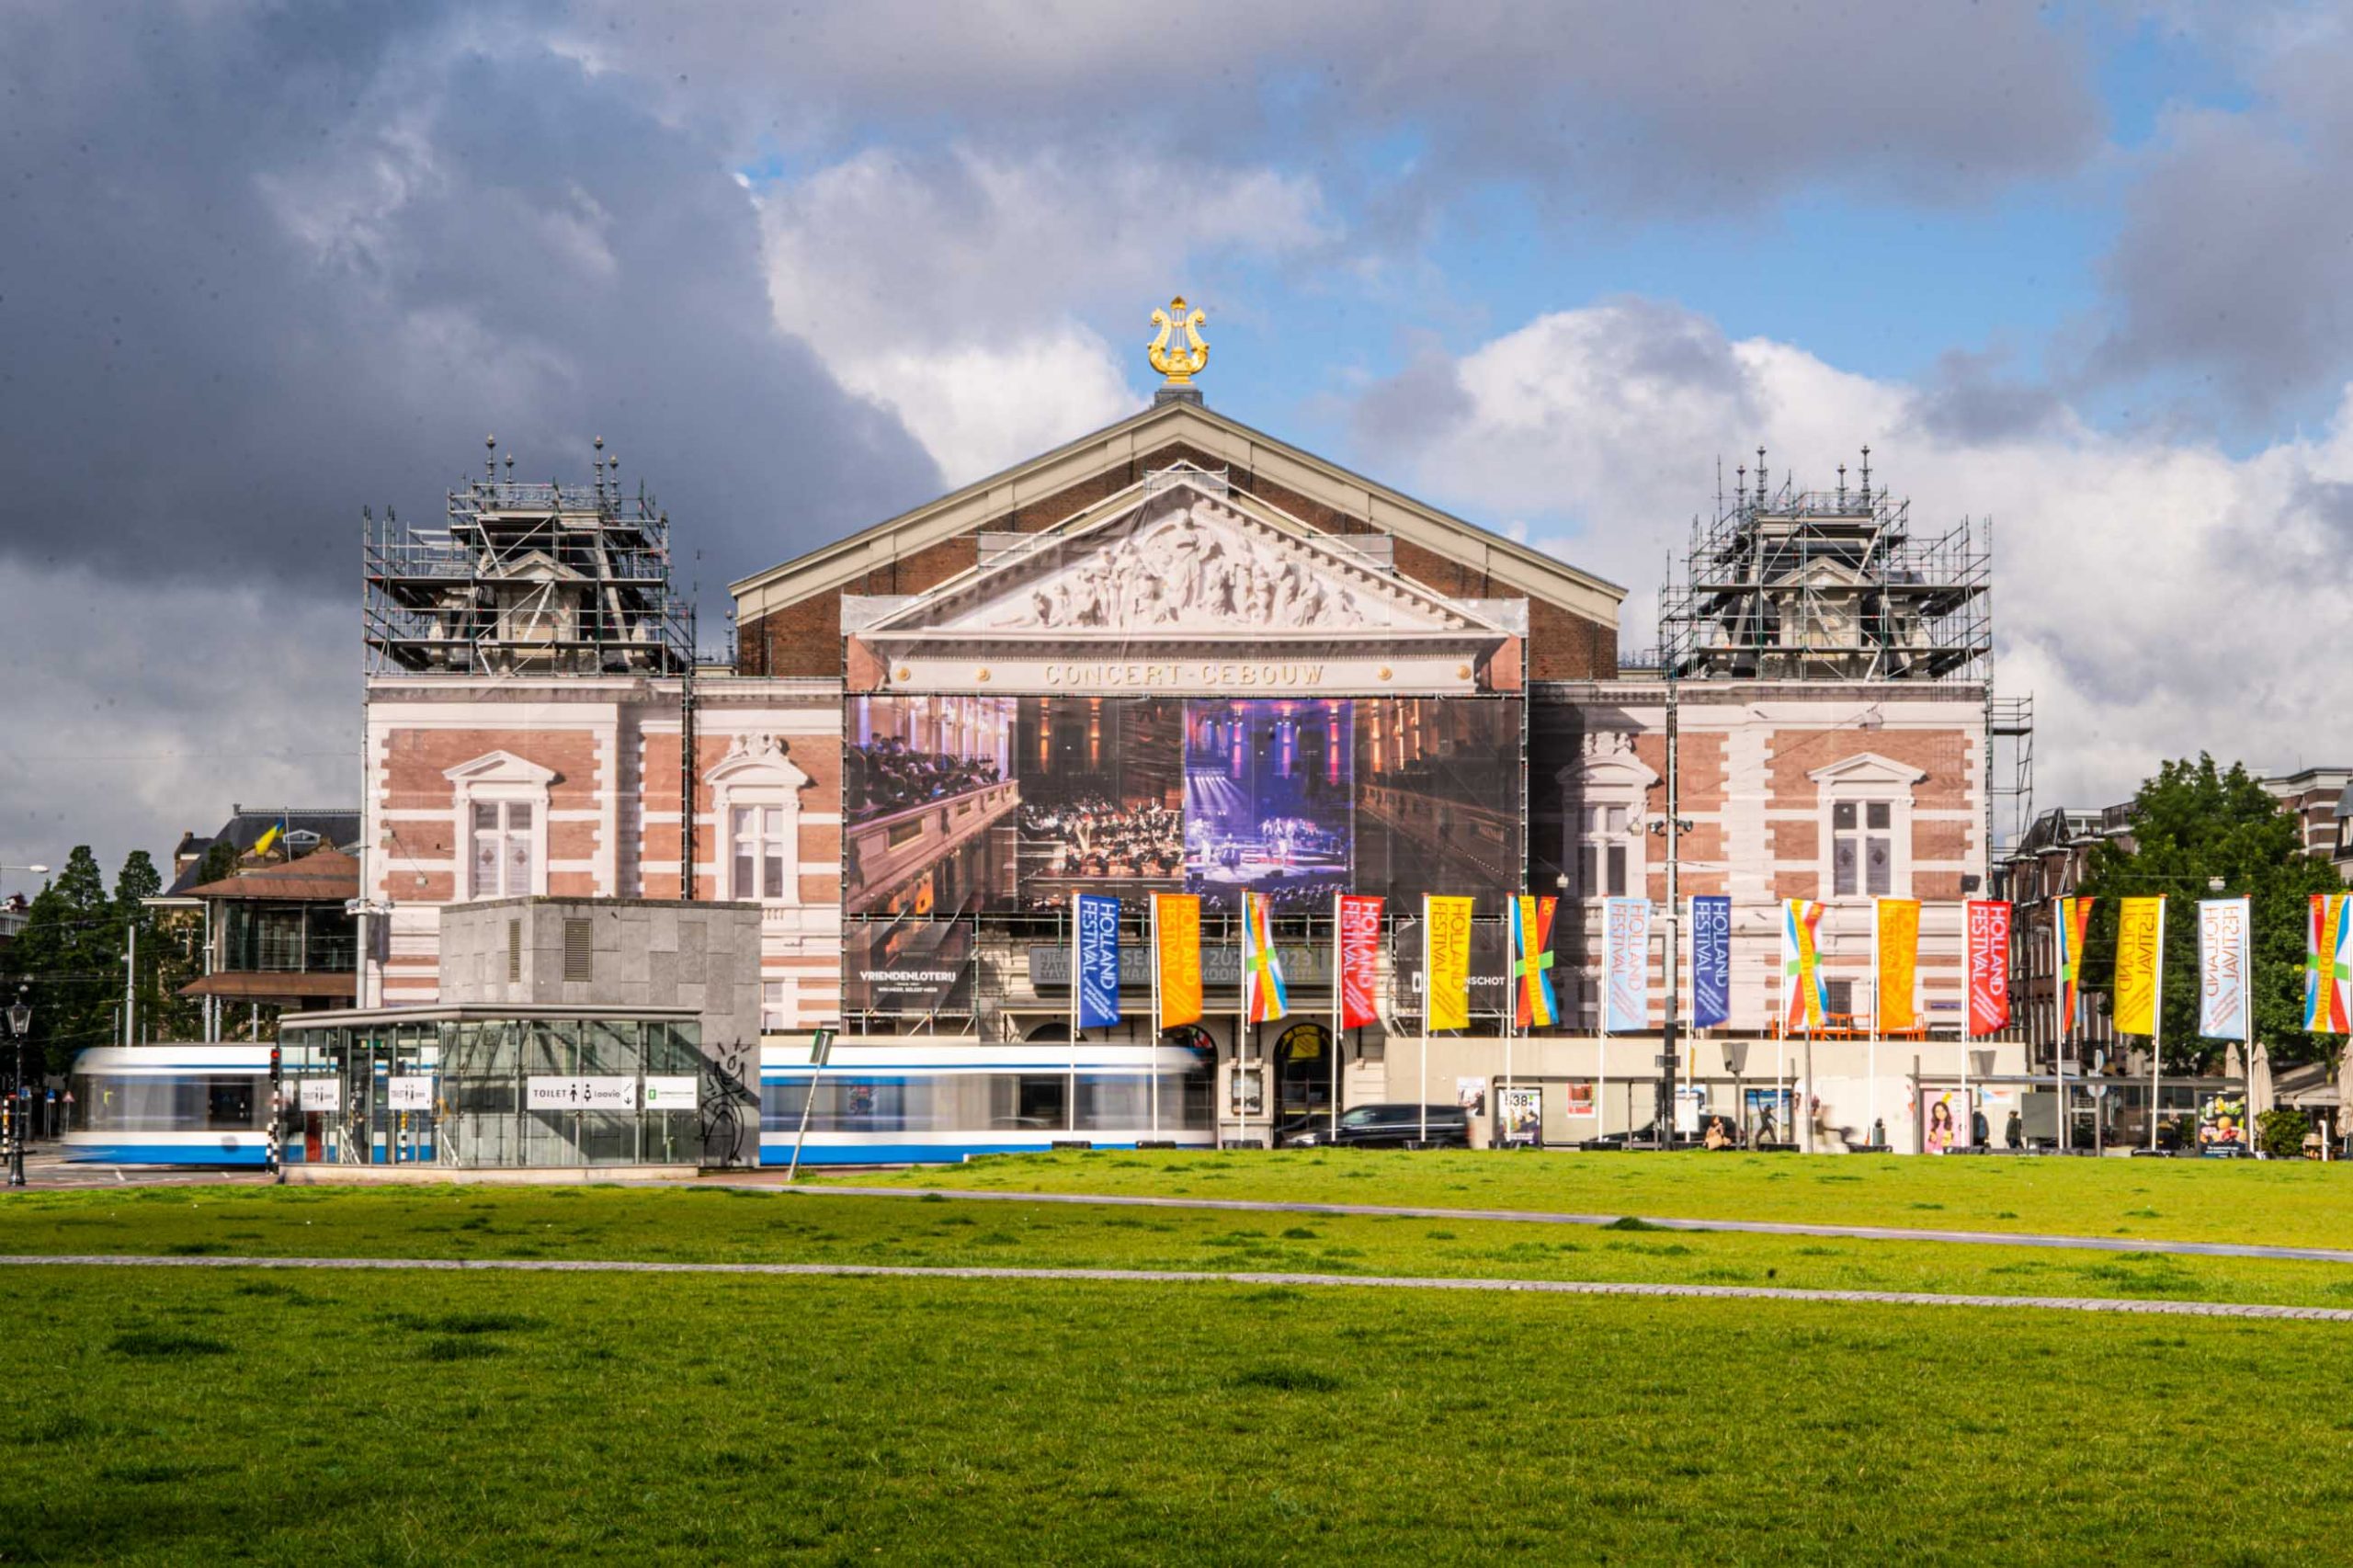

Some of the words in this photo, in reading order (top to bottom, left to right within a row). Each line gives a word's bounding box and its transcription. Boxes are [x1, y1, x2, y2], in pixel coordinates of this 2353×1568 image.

[1082, 901, 1098, 974] FESTIVAL
[1099, 903, 1117, 990] HOLLAND
[1161, 900, 1179, 974] FESTIVAL
[1180, 900, 1199, 986] HOLLAND
[1342, 901, 1361, 975] FESTIVAL
[1357, 903, 1379, 989] HOLLAND
[1432, 903, 1448, 976] FESTIVAL
[1450, 903, 1466, 990] HOLLAND
[1611, 904, 1627, 979] FESTIVAL
[1628, 904, 1645, 991] HOLLAND
[1695, 902, 1711, 975] FESTIVAL
[1712, 902, 1729, 987] HOLLAND
[1971, 905, 1989, 983] FESTIVAL
[1989, 906, 2006, 995] HOLLAND
[859, 971, 956, 983] VRIENDENLOTERIJ
[533, 1089, 566, 1097] TOILET
